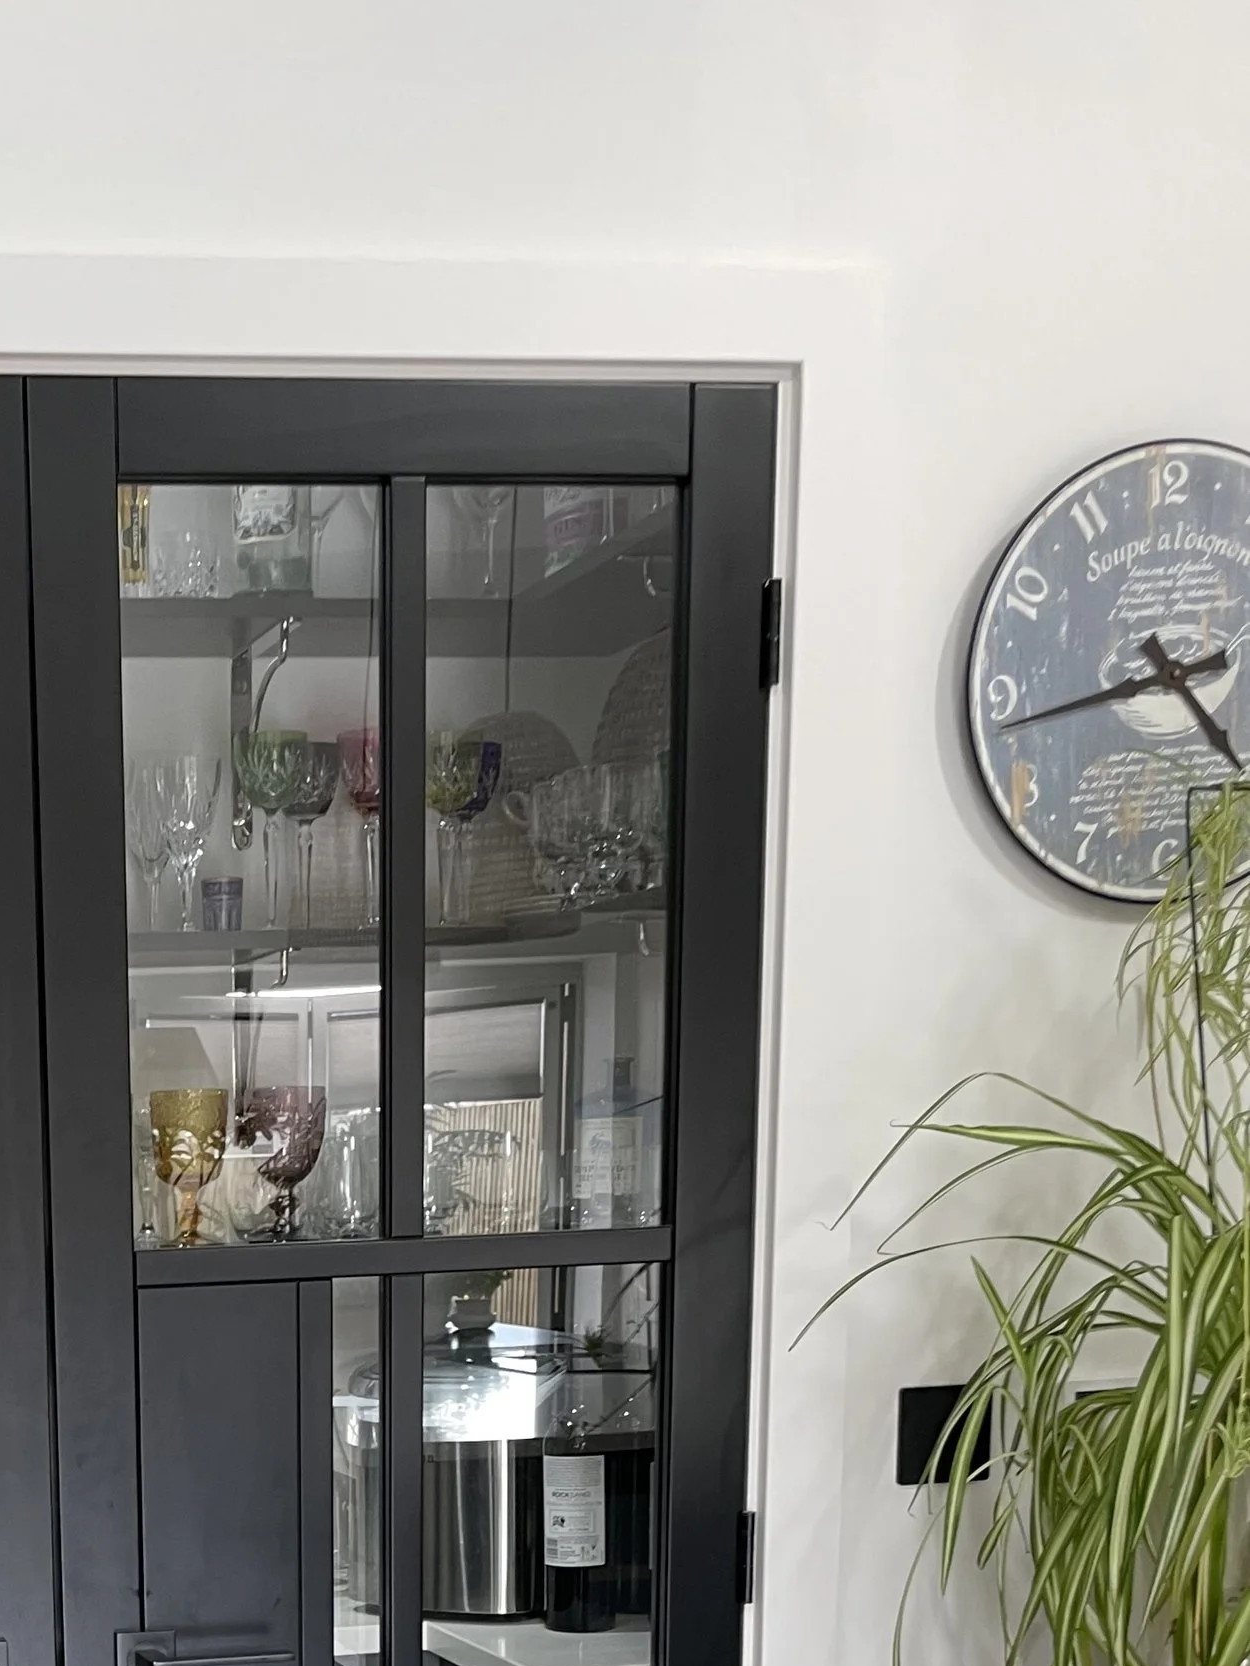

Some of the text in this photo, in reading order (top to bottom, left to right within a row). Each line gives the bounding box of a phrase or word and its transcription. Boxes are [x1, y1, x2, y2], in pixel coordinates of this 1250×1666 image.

[1149, 459, 1190, 509] 12
[1069, 489, 1109, 545] 11
[1086, 534, 1152, 582] Soupe
[1007, 565, 1048, 621] 10
[987, 675, 1018, 721] 9
[1073, 820, 1099, 865] 7
